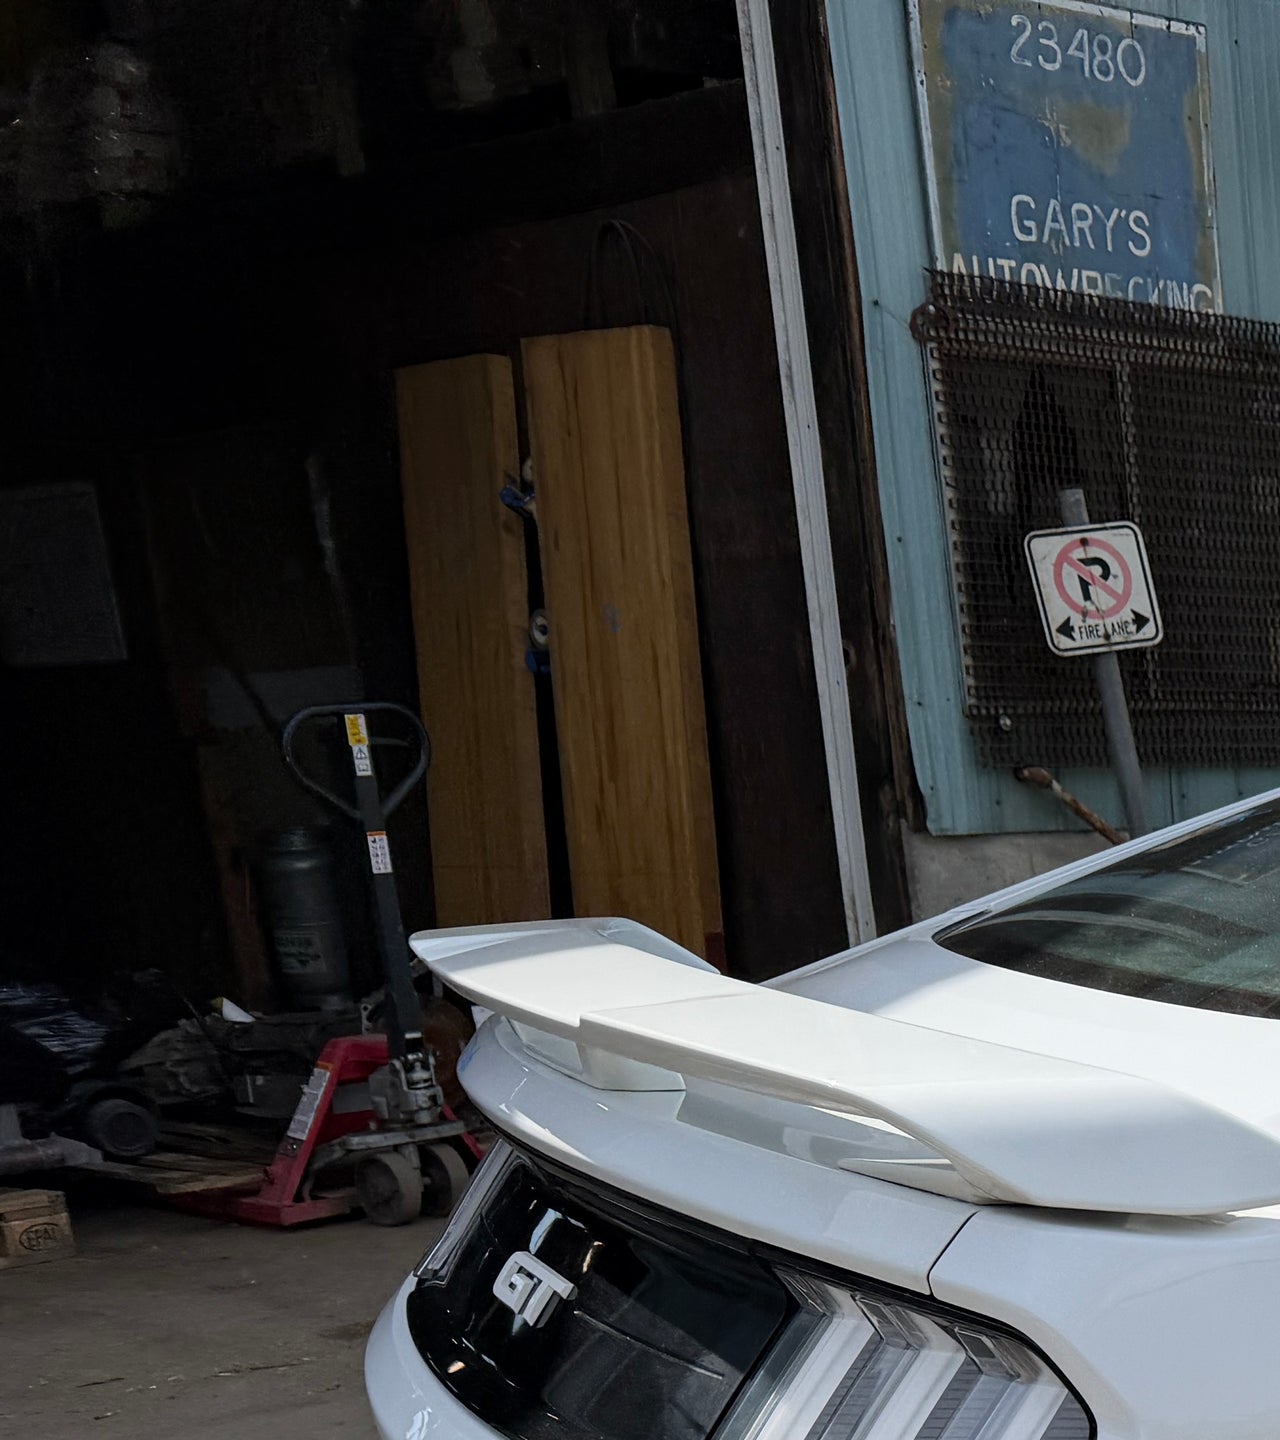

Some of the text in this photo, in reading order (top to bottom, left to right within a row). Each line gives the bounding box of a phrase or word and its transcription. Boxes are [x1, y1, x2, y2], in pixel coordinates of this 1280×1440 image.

[1010, 14, 1147, 87] 23480
[1010, 193, 1151, 256] GARY'S
[1078, 623, 1101, 640] FIRE
[492, 1251, 578, 1329] GT
